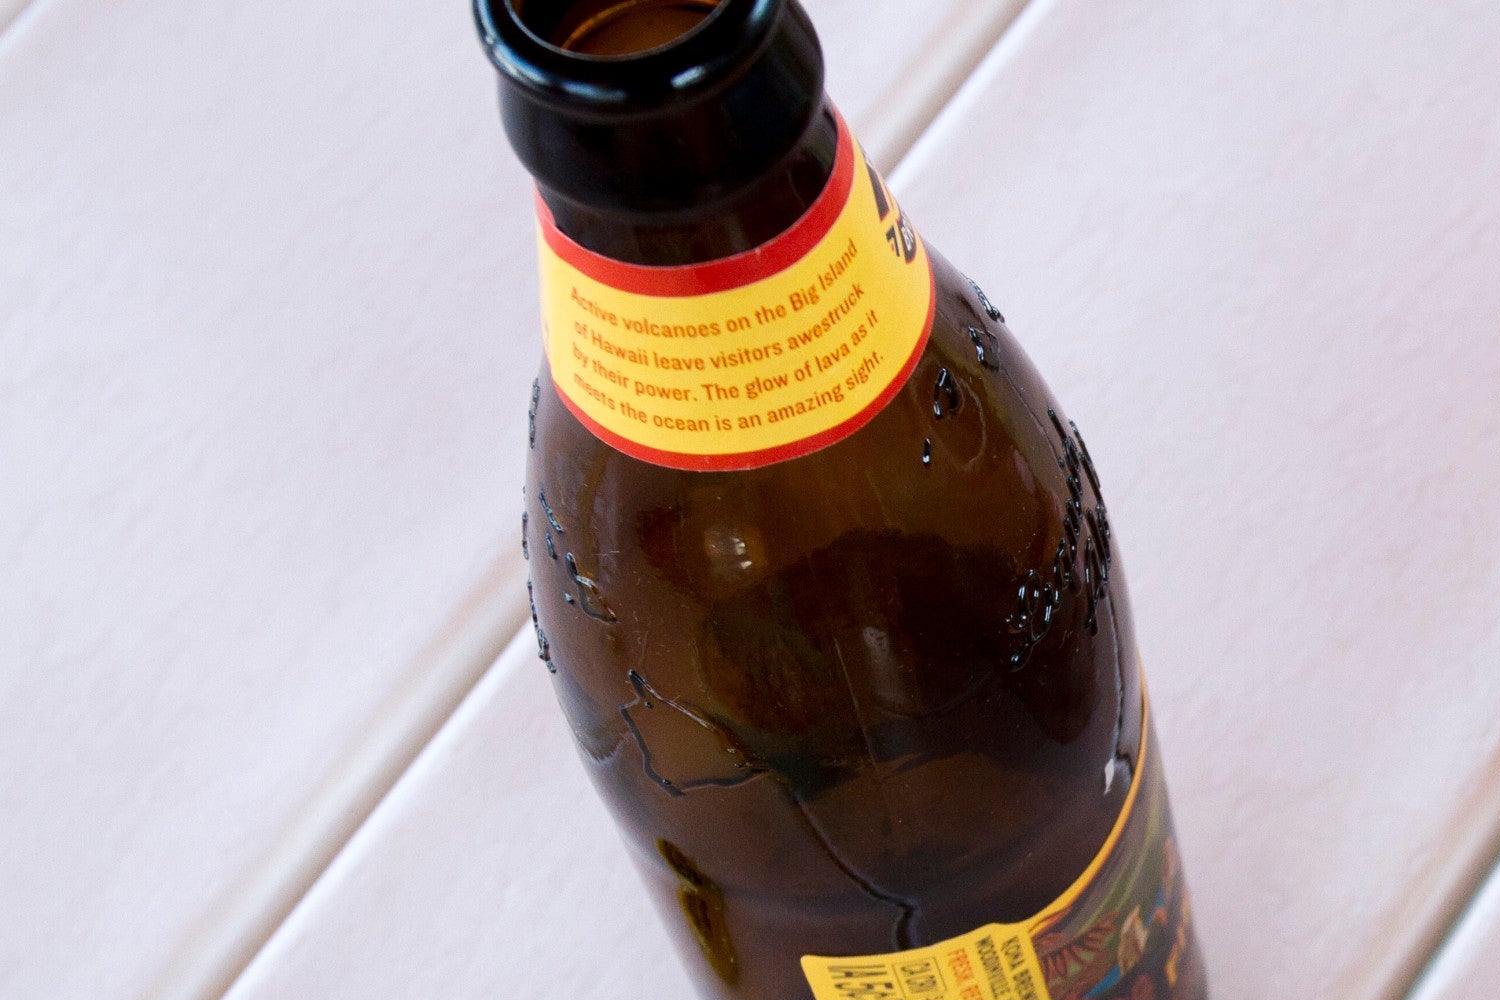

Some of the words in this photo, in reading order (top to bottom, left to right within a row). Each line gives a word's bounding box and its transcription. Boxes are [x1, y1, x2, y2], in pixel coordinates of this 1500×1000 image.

[571, 287, 618, 326] Active
[623, 317, 720, 339] volcanoes
[726, 315, 751, 333] on
[755, 306, 786, 325] the
[789, 285, 819, 312] Big
[818, 238, 858, 291] Island
[574, 321, 587, 340] of
[591, 330, 648, 366] Hawaii
[654, 351, 705, 371] leave
[710, 342, 783, 369] visitors
[788, 283, 864, 350] awestruck
[573, 343, 589, 367] by
[593, 360, 629, 388] their
[634, 381, 697, 401] power.
[703, 384, 739, 401] The
[746, 373, 788, 399] glow
[794, 361, 813, 382] of
[815, 343, 850, 372] lava
[851, 325, 868, 347] as
[866, 309, 878, 329] it
[574, 372, 615, 410] meets
[620, 402, 647, 423] the
[653, 415, 710, 431] ocean
[716, 416, 732, 431] is
[738, 414, 762, 429] an
[767, 384, 844, 423] amazing
[845, 351, 884, 390] sight.
